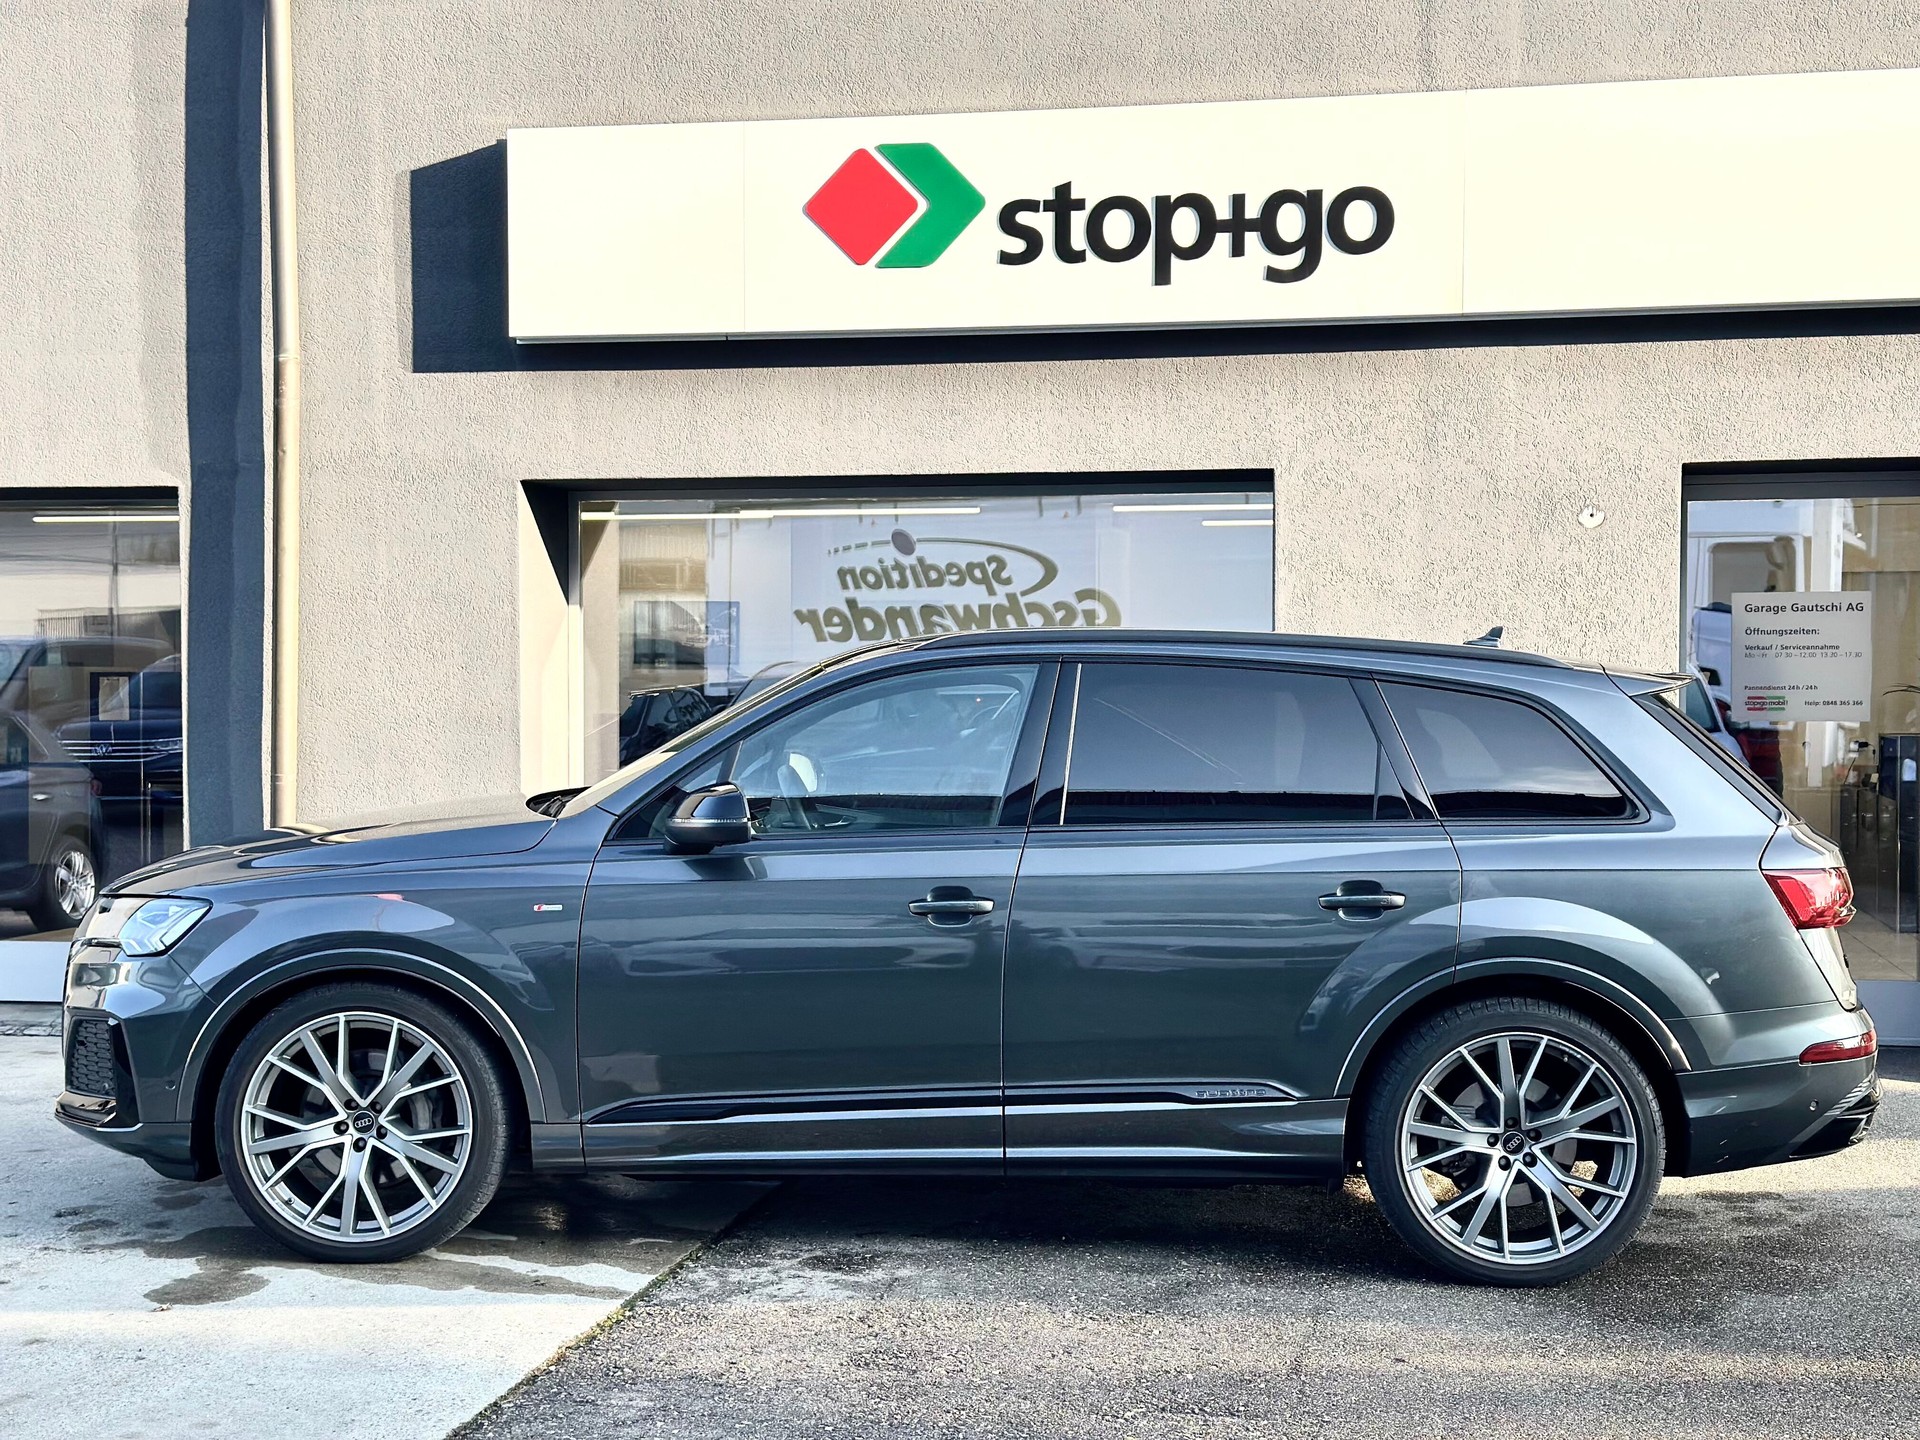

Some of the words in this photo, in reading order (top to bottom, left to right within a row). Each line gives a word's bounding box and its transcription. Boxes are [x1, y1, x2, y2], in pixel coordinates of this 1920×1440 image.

[996, 180, 1395, 286] stop+go
[1744, 603, 1787, 615] Garage
[1790, 602, 1842, 613] Gautschi
[1846, 602, 1864, 612] AG
[1744, 626, 1820, 637] Öffnungszeiten:
